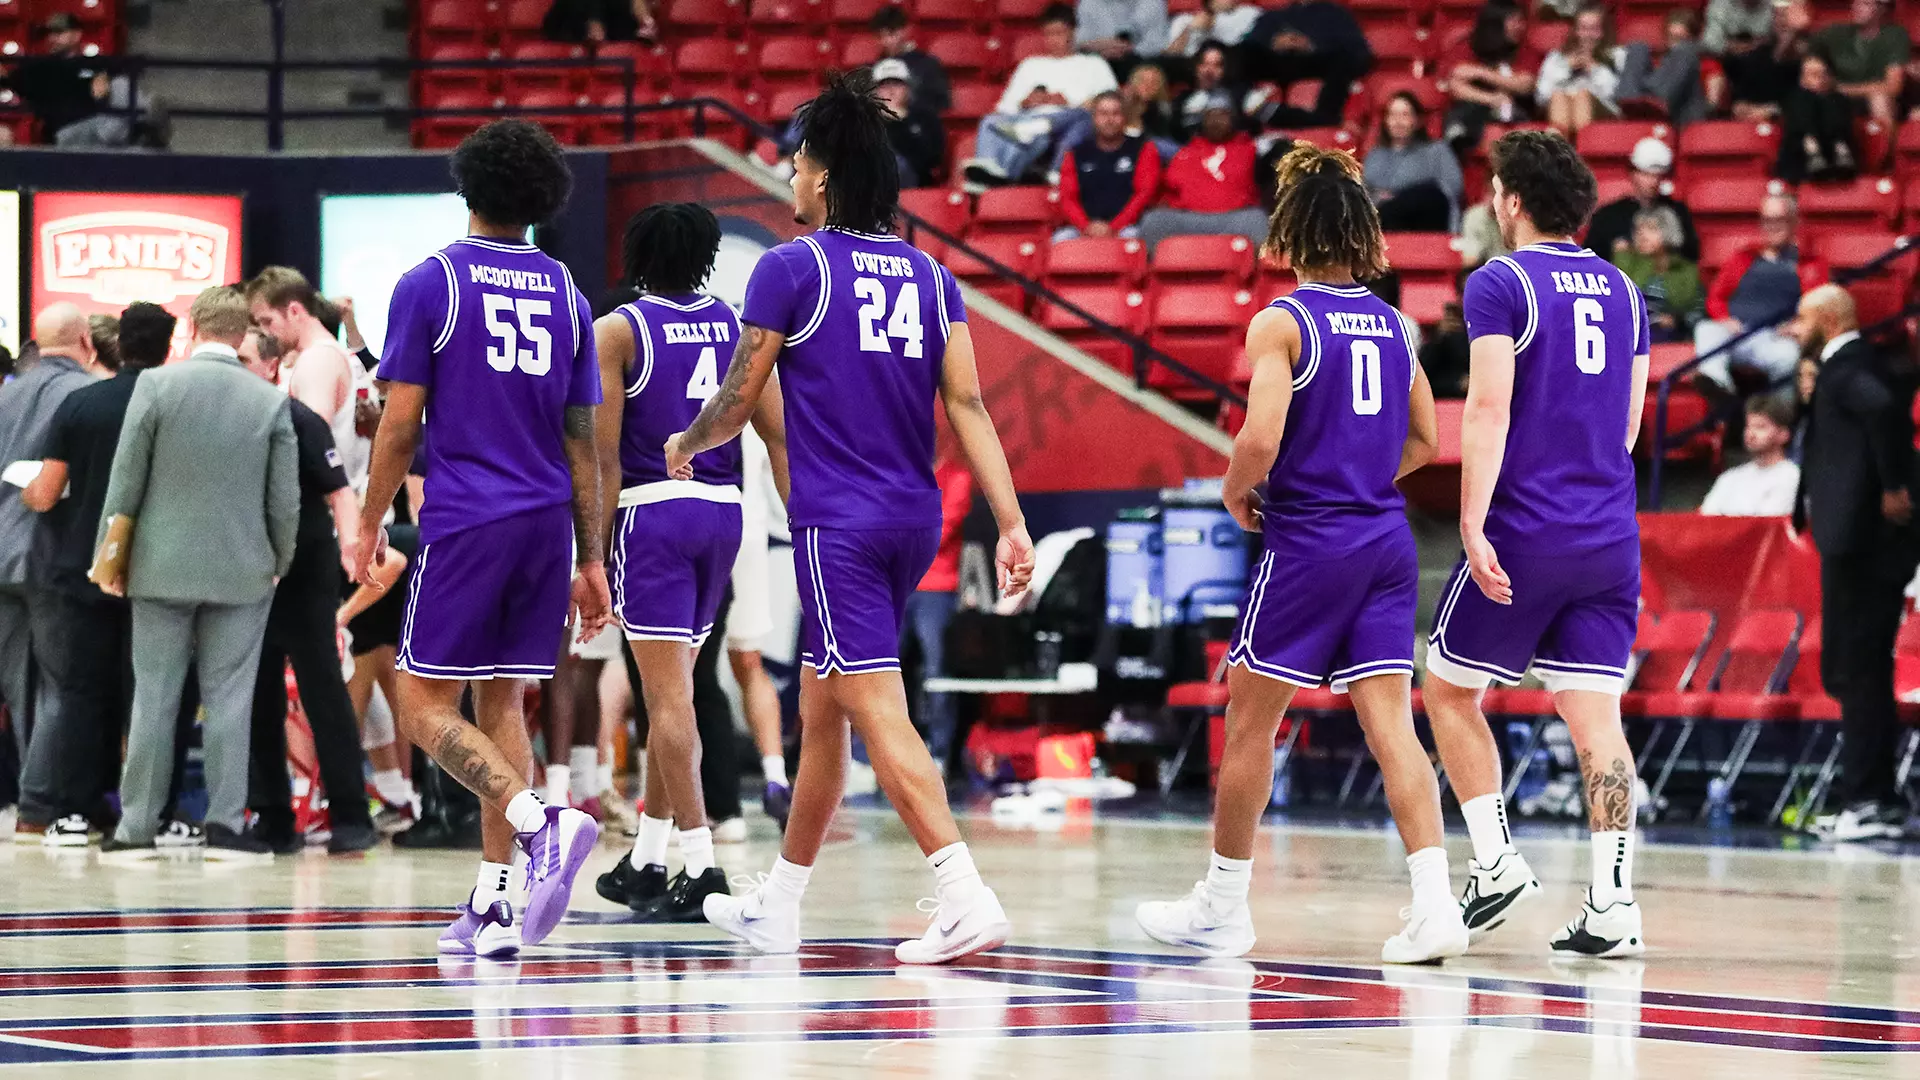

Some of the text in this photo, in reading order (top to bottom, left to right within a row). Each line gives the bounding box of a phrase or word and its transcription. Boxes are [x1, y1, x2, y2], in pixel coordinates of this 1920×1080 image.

[54, 231, 215, 280] ERNIE'S
[468, 264, 557, 294] MCDOWELL
[851, 251, 914, 279] OWENS
[1550, 271, 1612, 297] ISAAC
[482, 293, 552, 377] 55
[661, 321, 730, 345] KELLY IV
[856, 277, 924, 359] 24
[1324, 311, 1394, 339] MIZELL
[1572, 298, 1606, 375] 6
[685, 346, 721, 411] 4
[1349, 339, 1382, 416] 0
